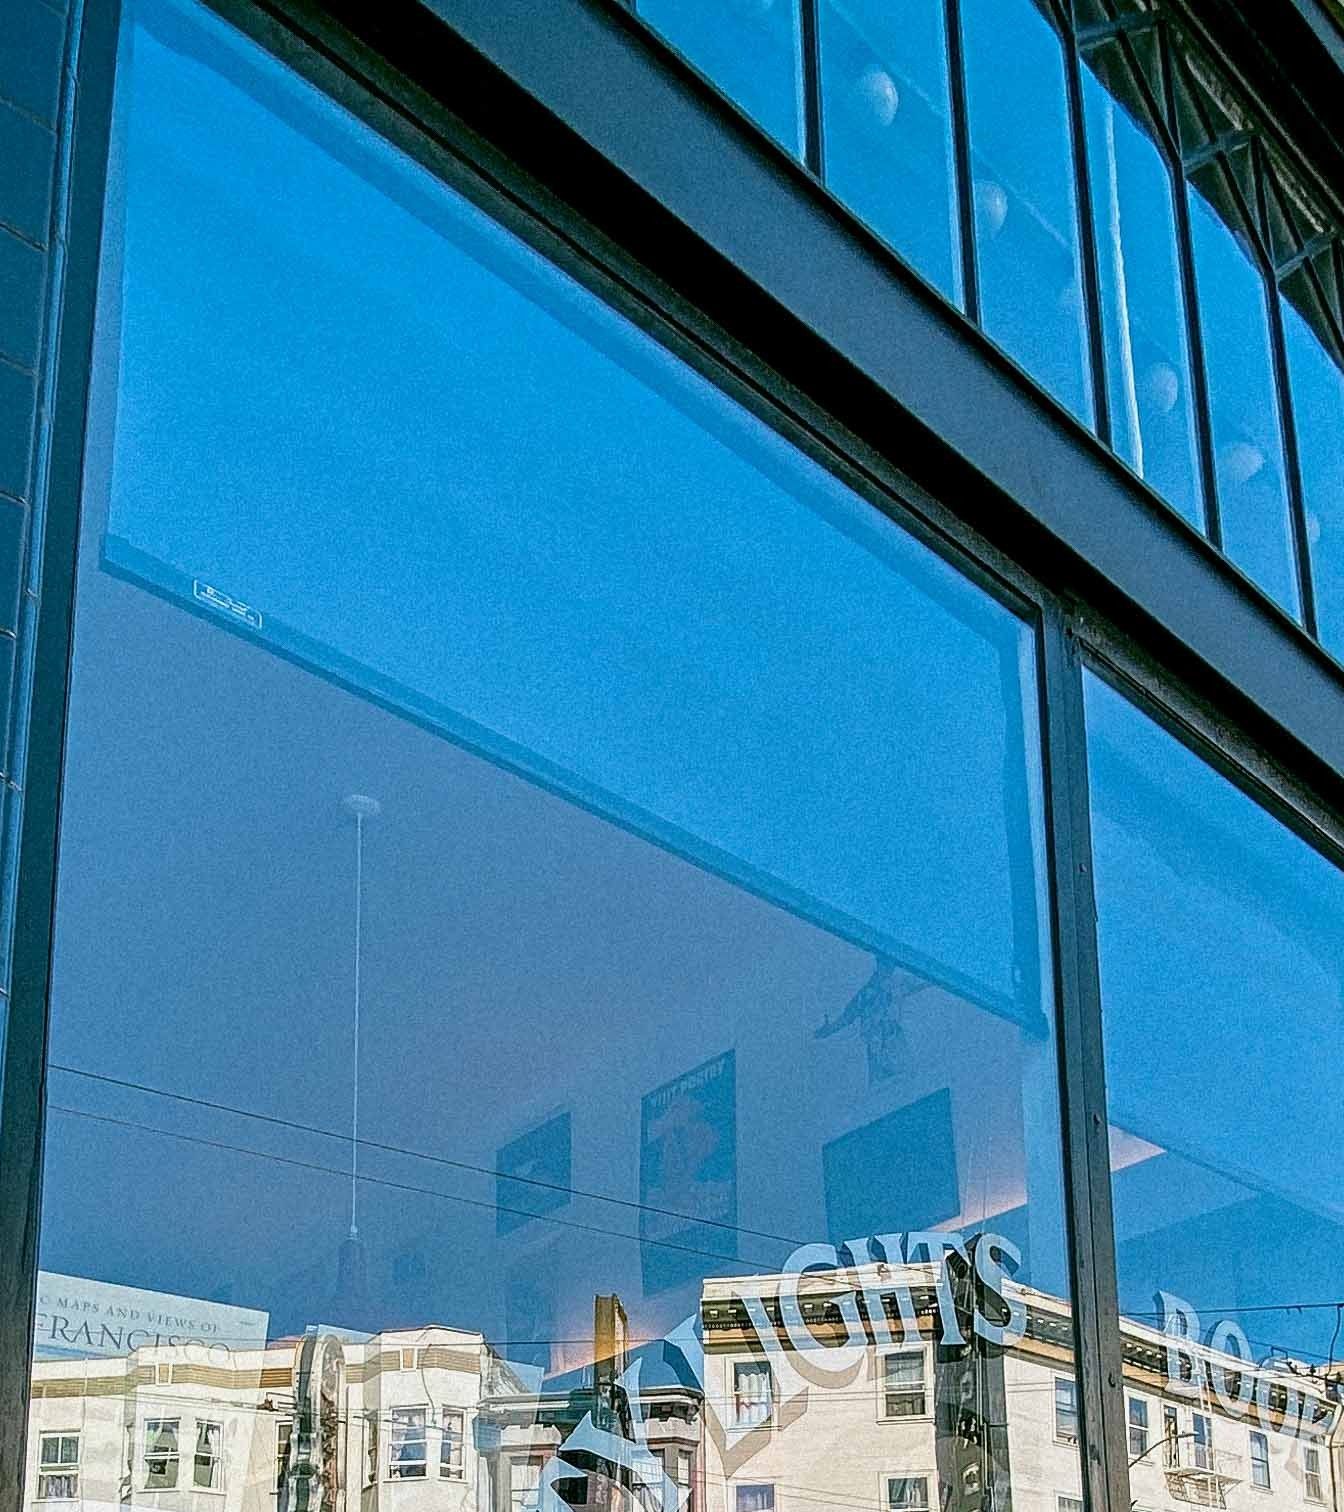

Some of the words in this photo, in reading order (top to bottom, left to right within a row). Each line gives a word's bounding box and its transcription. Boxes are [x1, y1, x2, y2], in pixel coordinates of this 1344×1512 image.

[57, 1297, 100, 1314] MAPS
[106, 1304, 141, 1321] AND
[147, 1311, 195, 1330] VIEWS
[200, 1322, 221, 1334] OF
